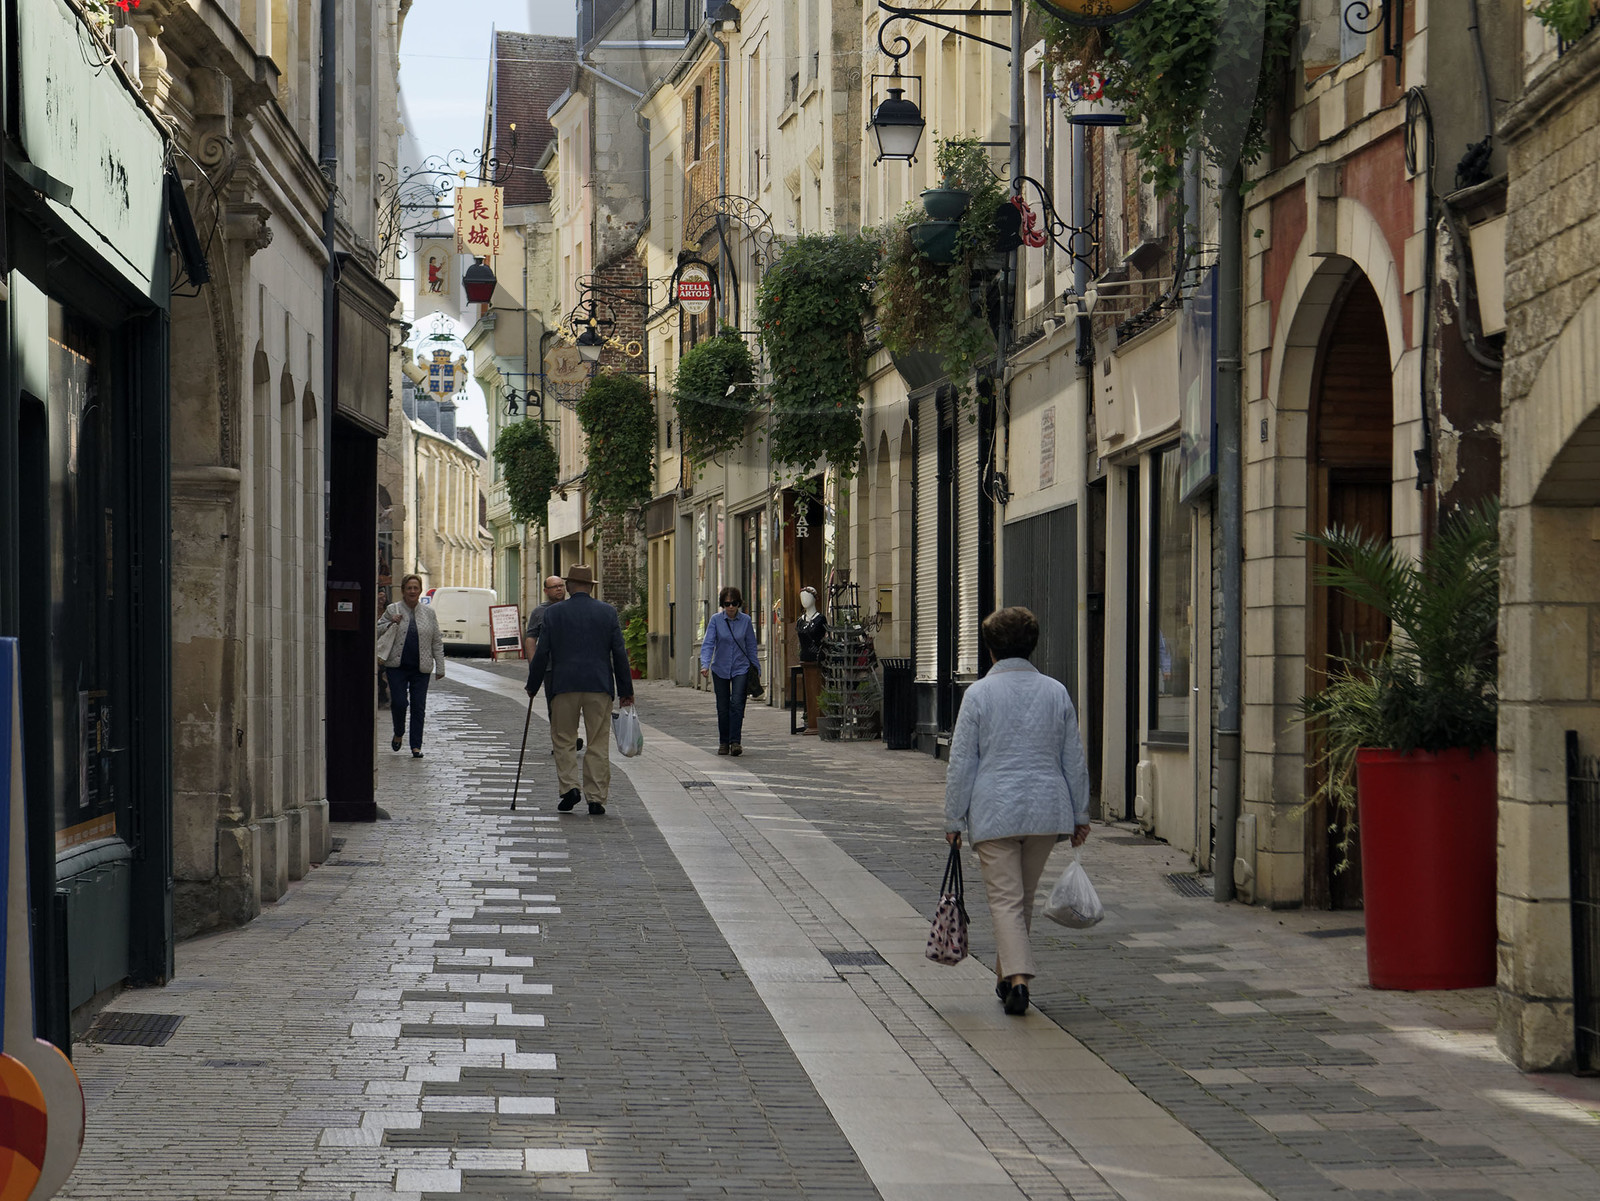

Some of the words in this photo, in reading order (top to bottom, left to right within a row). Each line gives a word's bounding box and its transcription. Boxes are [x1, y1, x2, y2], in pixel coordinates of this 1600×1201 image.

[1080, 4, 1113, 16] 1978
[468, 198, 490, 247] 長城
[796, 502, 810, 538] BAR
